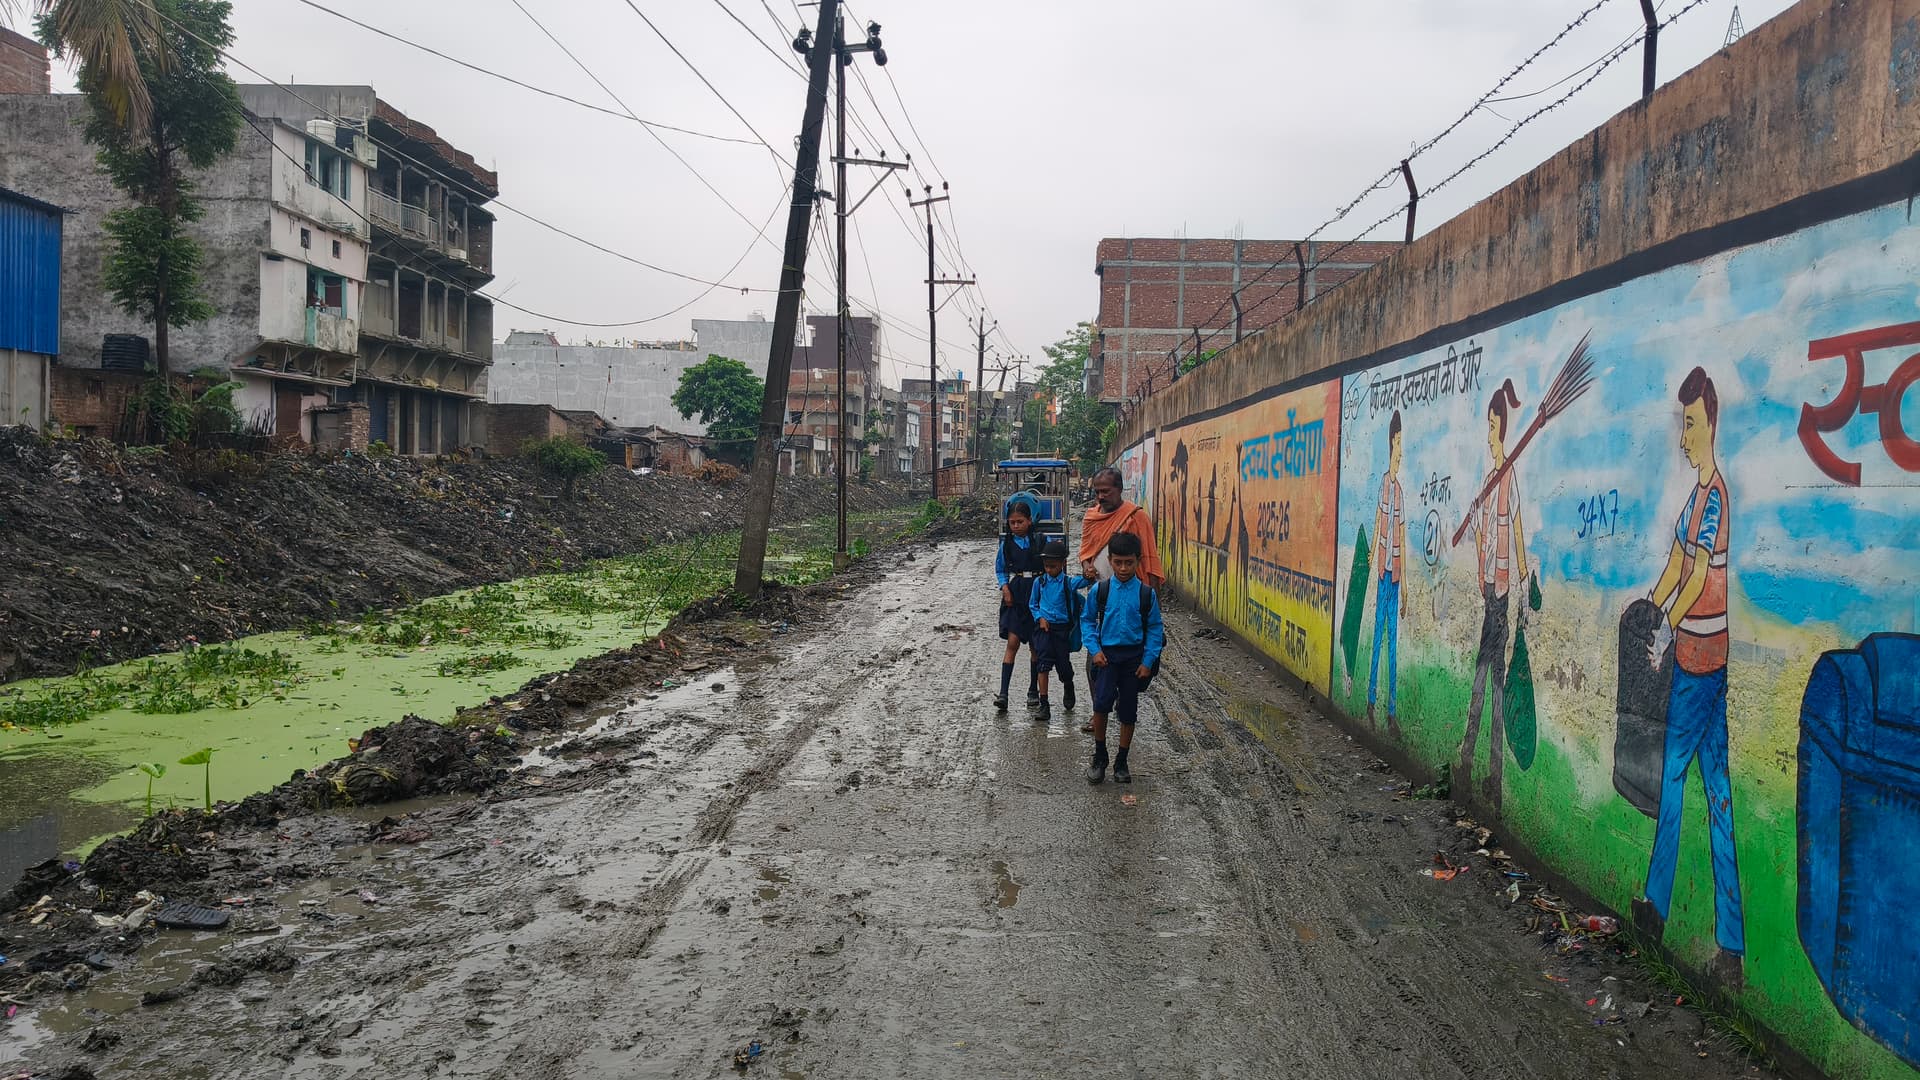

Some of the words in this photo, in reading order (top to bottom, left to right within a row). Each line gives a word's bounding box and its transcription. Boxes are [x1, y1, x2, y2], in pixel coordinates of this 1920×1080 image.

[1381, 375, 1402, 412] कदम
[1401, 362, 1441, 410] स्वच्छता
[1441, 345, 1458, 396] की
[1257, 500, 1290, 542] 2025-26
